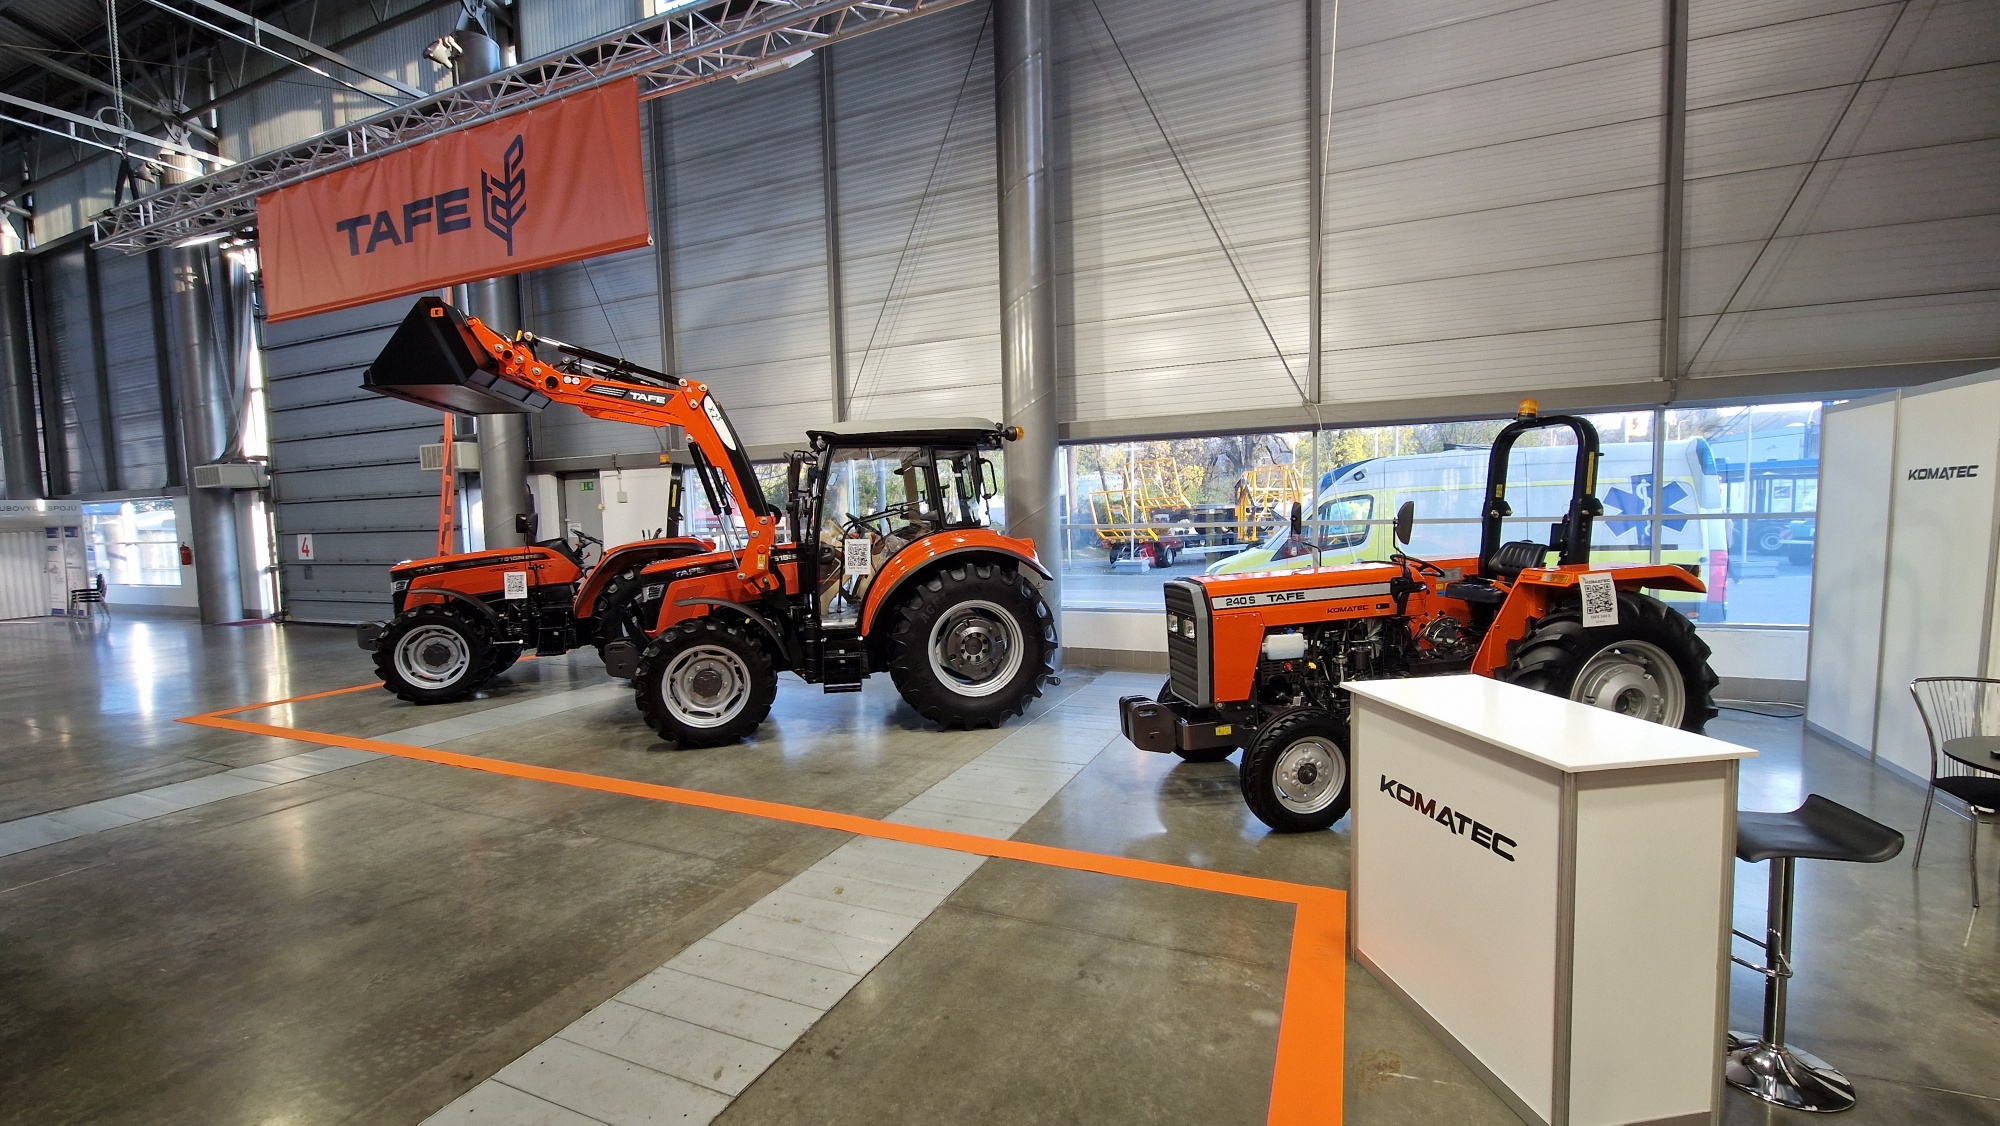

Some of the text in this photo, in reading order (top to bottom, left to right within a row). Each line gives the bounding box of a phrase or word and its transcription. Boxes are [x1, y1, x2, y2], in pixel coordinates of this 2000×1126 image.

[336, 187, 471, 256] TAFE
[629, 391, 666, 404] TAFE
[1907, 464, 1979, 481] KOMATEC
[301, 536, 310, 557] 4
[1225, 591, 1305, 607] 240 S TAFE
[1326, 604, 1369, 614] KOMATEC
[1379, 773, 1518, 863] KOMATEC
